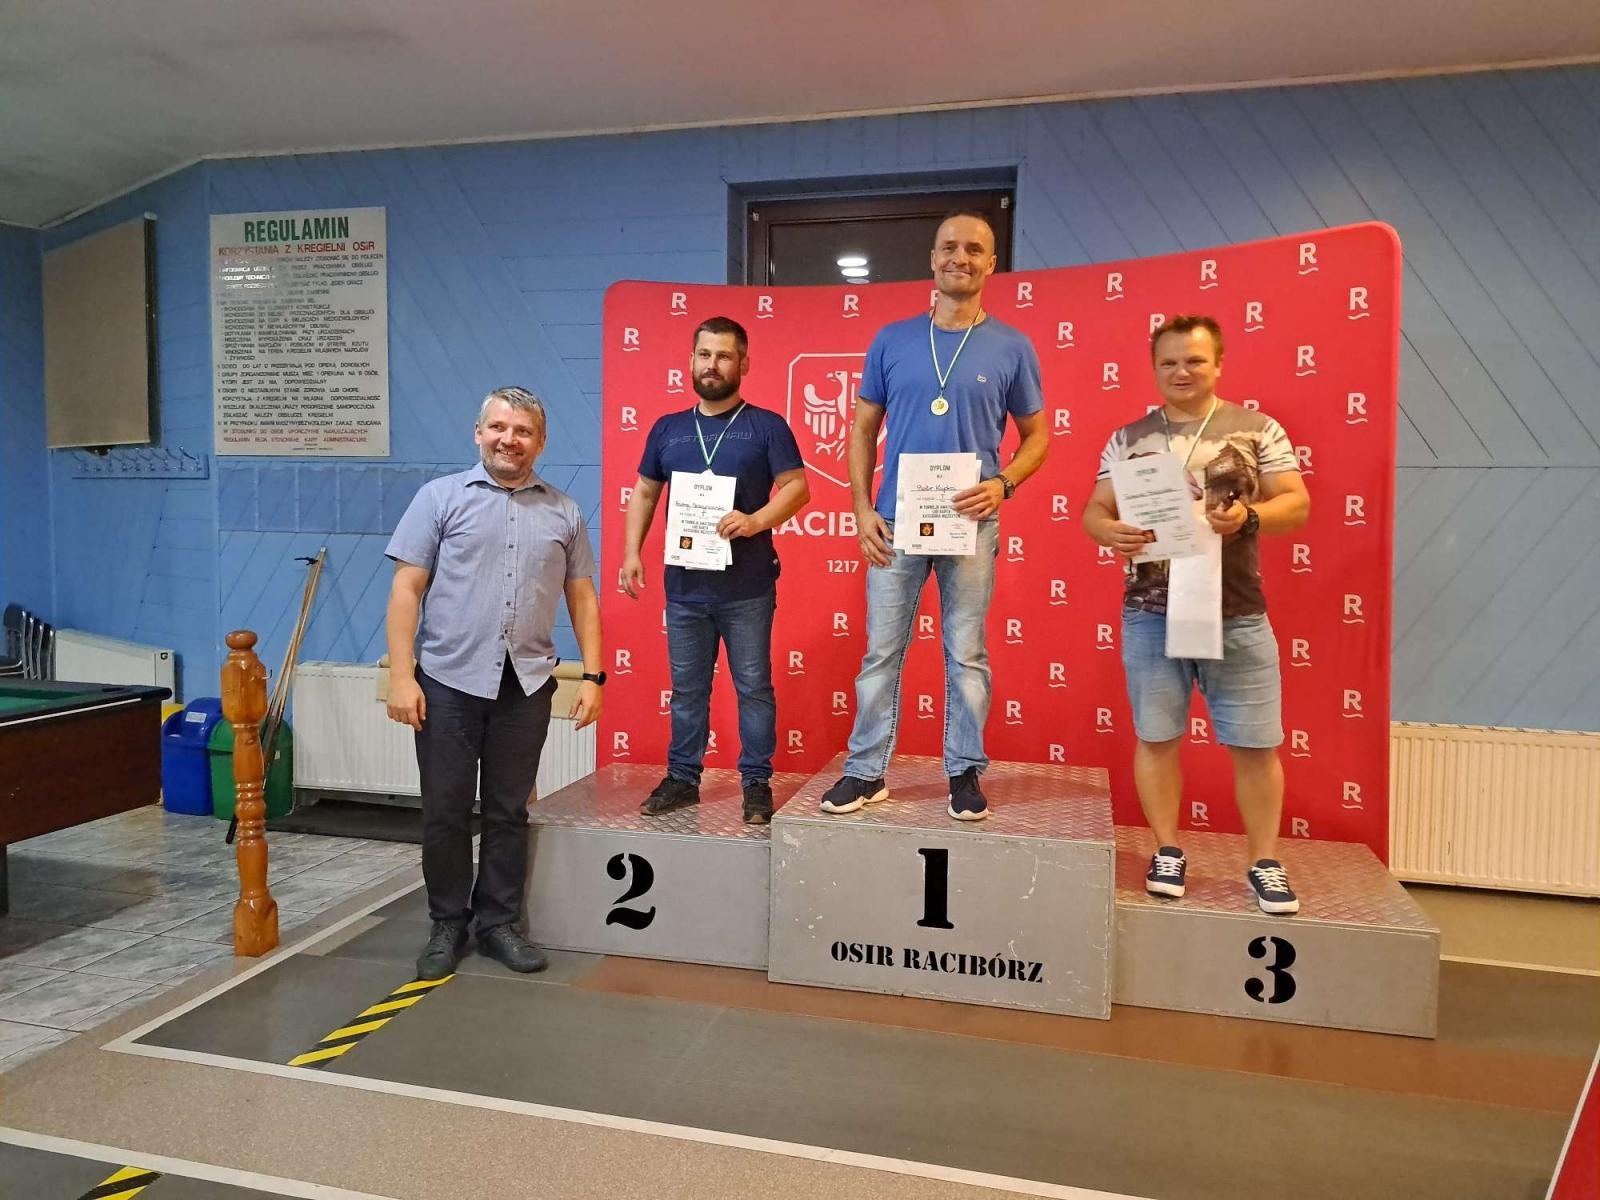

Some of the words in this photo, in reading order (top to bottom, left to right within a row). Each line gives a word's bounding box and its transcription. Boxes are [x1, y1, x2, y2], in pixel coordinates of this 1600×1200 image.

[244, 217, 349, 242] REGULAMIN
[285, 245, 291, 253] Z
[1299, 242, 1316, 266] R
[1200, 260, 1218, 282] R
[1017, 282, 1032, 300] R
[1107, 272, 1122, 292] R
[671, 292, 686, 310] R
[758, 296, 772, 312] R
[843, 294, 858, 310] R
[1349, 286, 1368, 310] R
[1246, 302, 1264, 324] R
[623, 328, 640, 346] R
[1057, 322, 1074, 340] R
[1297, 346, 1316, 368] R
[667, 368, 684, 386] R
[1103, 362, 1118, 382] R
[1347, 392, 1366, 414] R
[621, 406, 638, 424] R
[1054, 408, 1070, 428] R
[1052, 494, 1068, 514] R
[1345, 496, 1364, 516] R
[772, 511, 858, 537] ACIB
[1007, 536, 1024, 554] R
[1293, 544, 1310, 564] R
[827, 560, 859, 573] 1217
[1050, 580, 1066, 598] R
[1344, 594, 1362, 616] R
[833, 612, 848, 630] R
[919, 616, 934, 632] R
[1006, 618, 1022, 638] R
[1097, 624, 1114, 642] R
[615, 650, 632, 666] R
[1292, 638, 1310, 660] R
[789, 650, 804, 668] R
[1049, 662, 1066, 680] R
[833, 692, 848, 708] R
[918, 694, 934, 712] R
[1006, 700, 1022, 718] R
[1343, 690, 1362, 710] R
[1097, 708, 1112, 726] R
[1191, 718, 1208, 736] R
[613, 732, 628, 750] R
[788, 730, 802, 746] R
[1291, 730, 1310, 750] R
[1049, 744, 1064, 762] R
[1343, 782, 1362, 802] R
[1191, 802, 1208, 820] R
[606, 853, 656, 930] 2
[916, 847, 954, 929] 1
[831, 941, 894, 967] OSIR
[902, 948, 1044, 983] RACIBÓRZ
[1244, 936, 1297, 1004] 3
